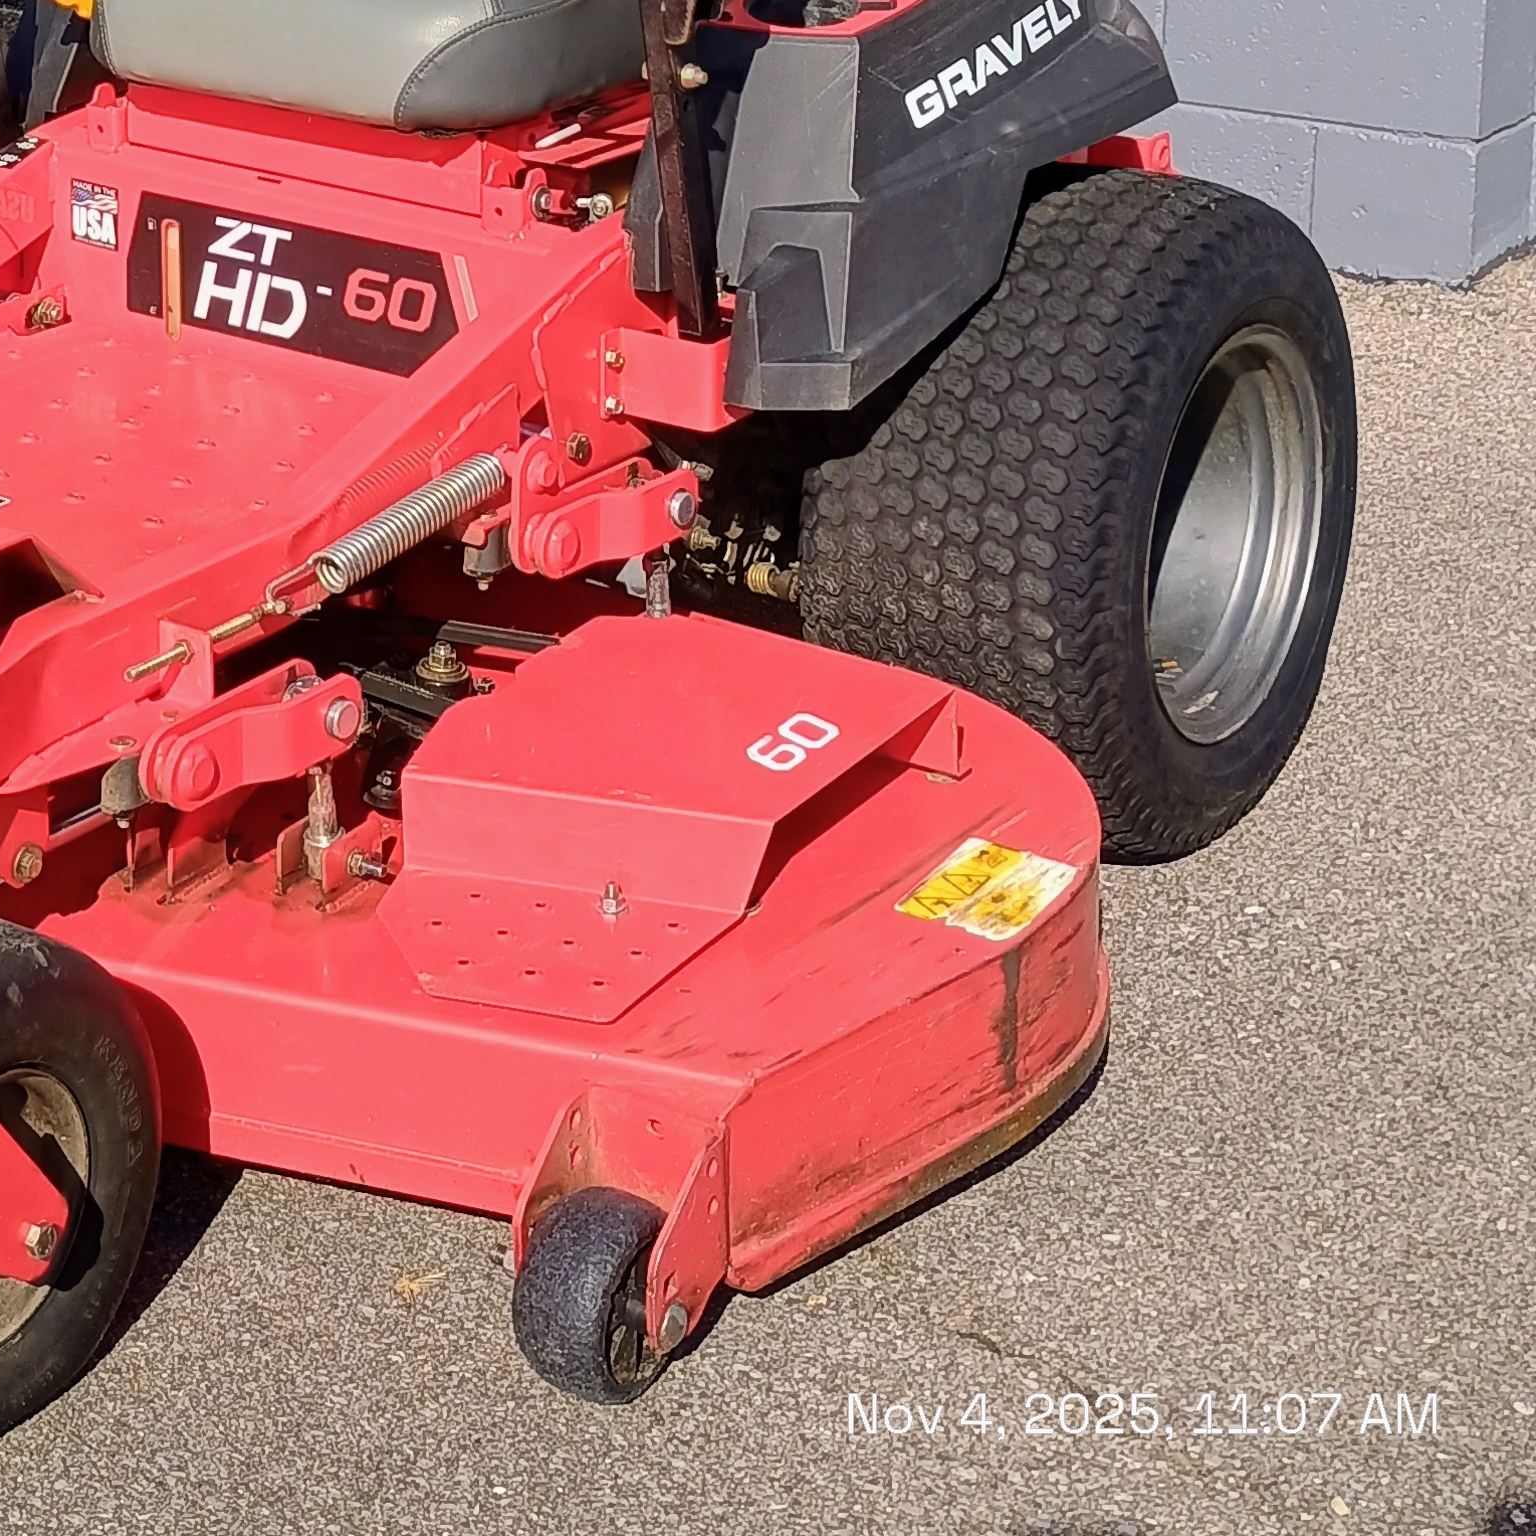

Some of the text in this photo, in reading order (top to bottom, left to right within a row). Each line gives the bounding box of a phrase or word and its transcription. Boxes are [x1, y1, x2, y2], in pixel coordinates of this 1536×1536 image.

[72, 179, 93, 193] MADE
[72, 204, 117, 246] USA
[207, 215, 293, 267] ZT
[746, 712, 840, 772] 60
